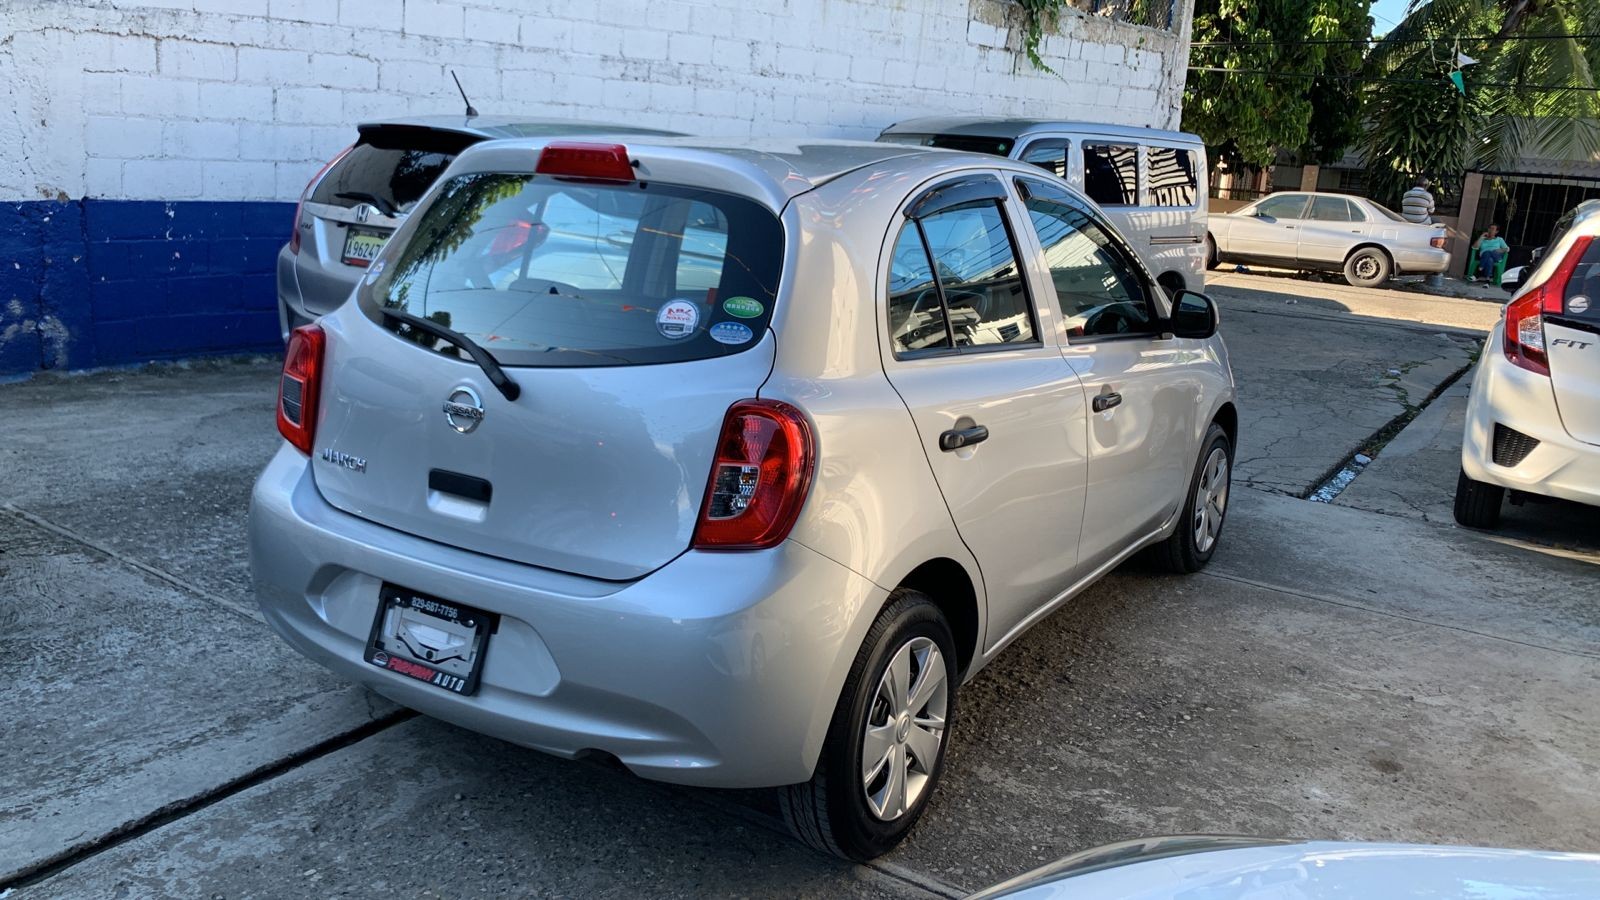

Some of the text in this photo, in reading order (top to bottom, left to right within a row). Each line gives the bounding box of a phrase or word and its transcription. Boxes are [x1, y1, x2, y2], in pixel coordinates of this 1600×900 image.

[346, 239, 384, 259] A96247
[1552, 338, 1593, 350] FIT
[443, 401, 485, 420] NISSAN
[322, 447, 367, 474] MARCH
[434, 672, 465, 692] AUTO
